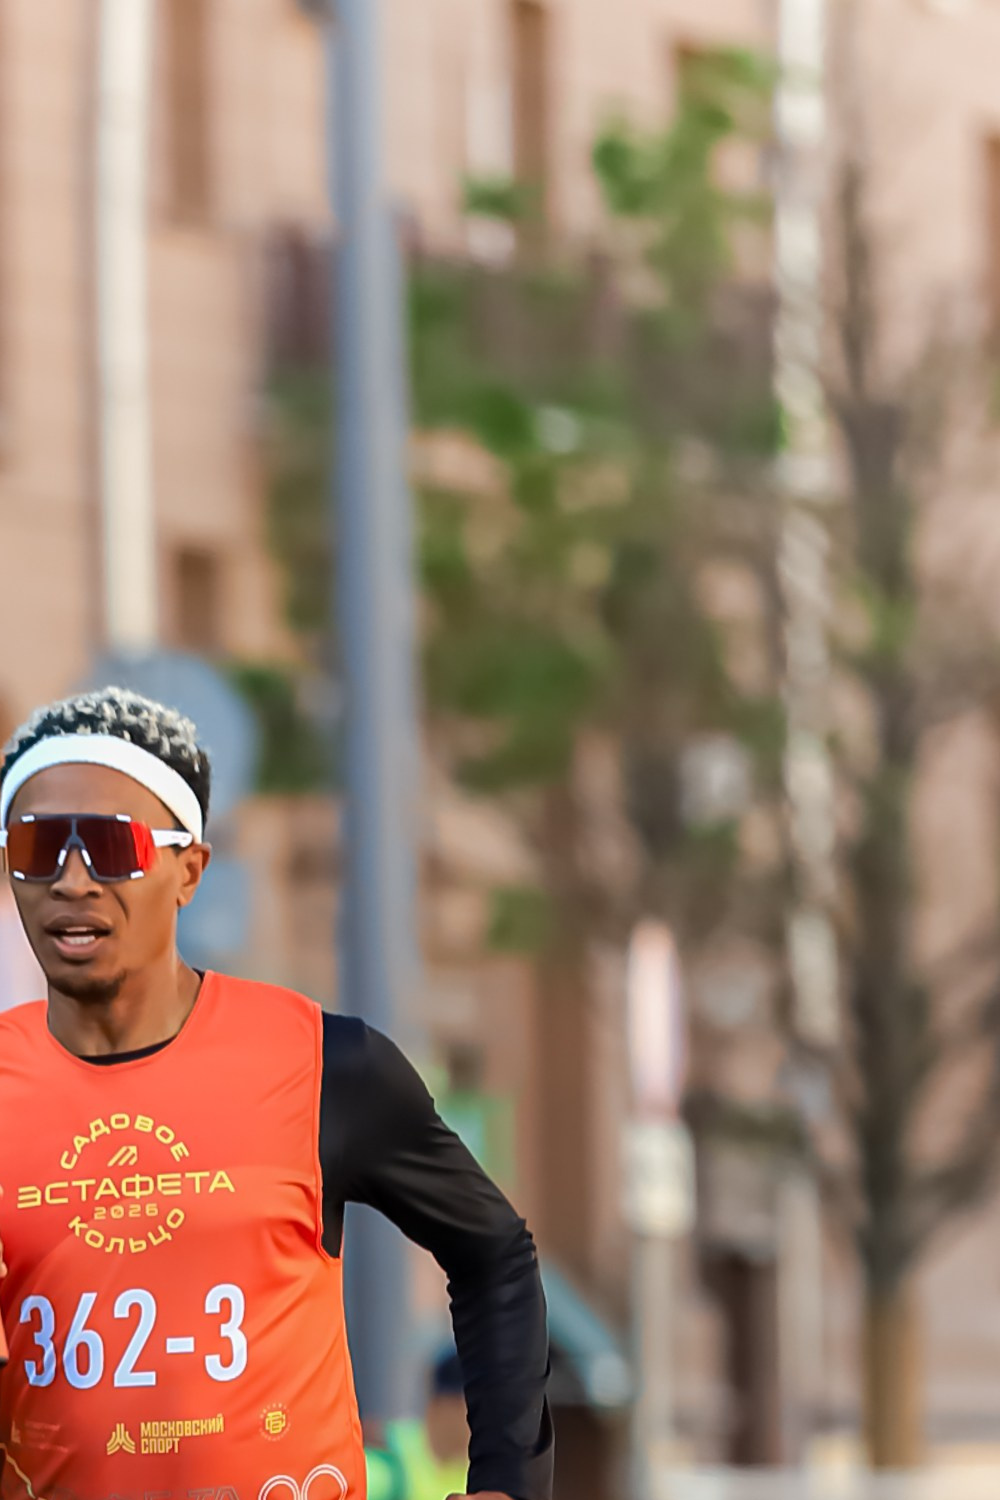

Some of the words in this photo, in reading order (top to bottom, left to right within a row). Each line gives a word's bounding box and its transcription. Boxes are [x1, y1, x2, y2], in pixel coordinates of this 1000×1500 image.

[60, 1113, 189, 1170] САДОВОЕ
[17, 1170, 235, 1209] ЭСТАФЕТА
[93, 1203, 159, 1220] 2026
[68, 1208, 185, 1255] КОЛЬЦО
[19, 1283, 248, 1389] 362-3
[140, 1413, 224, 1438] МОСКОВСКИЙ
[140, 1437, 180, 1455] СПОРТ
